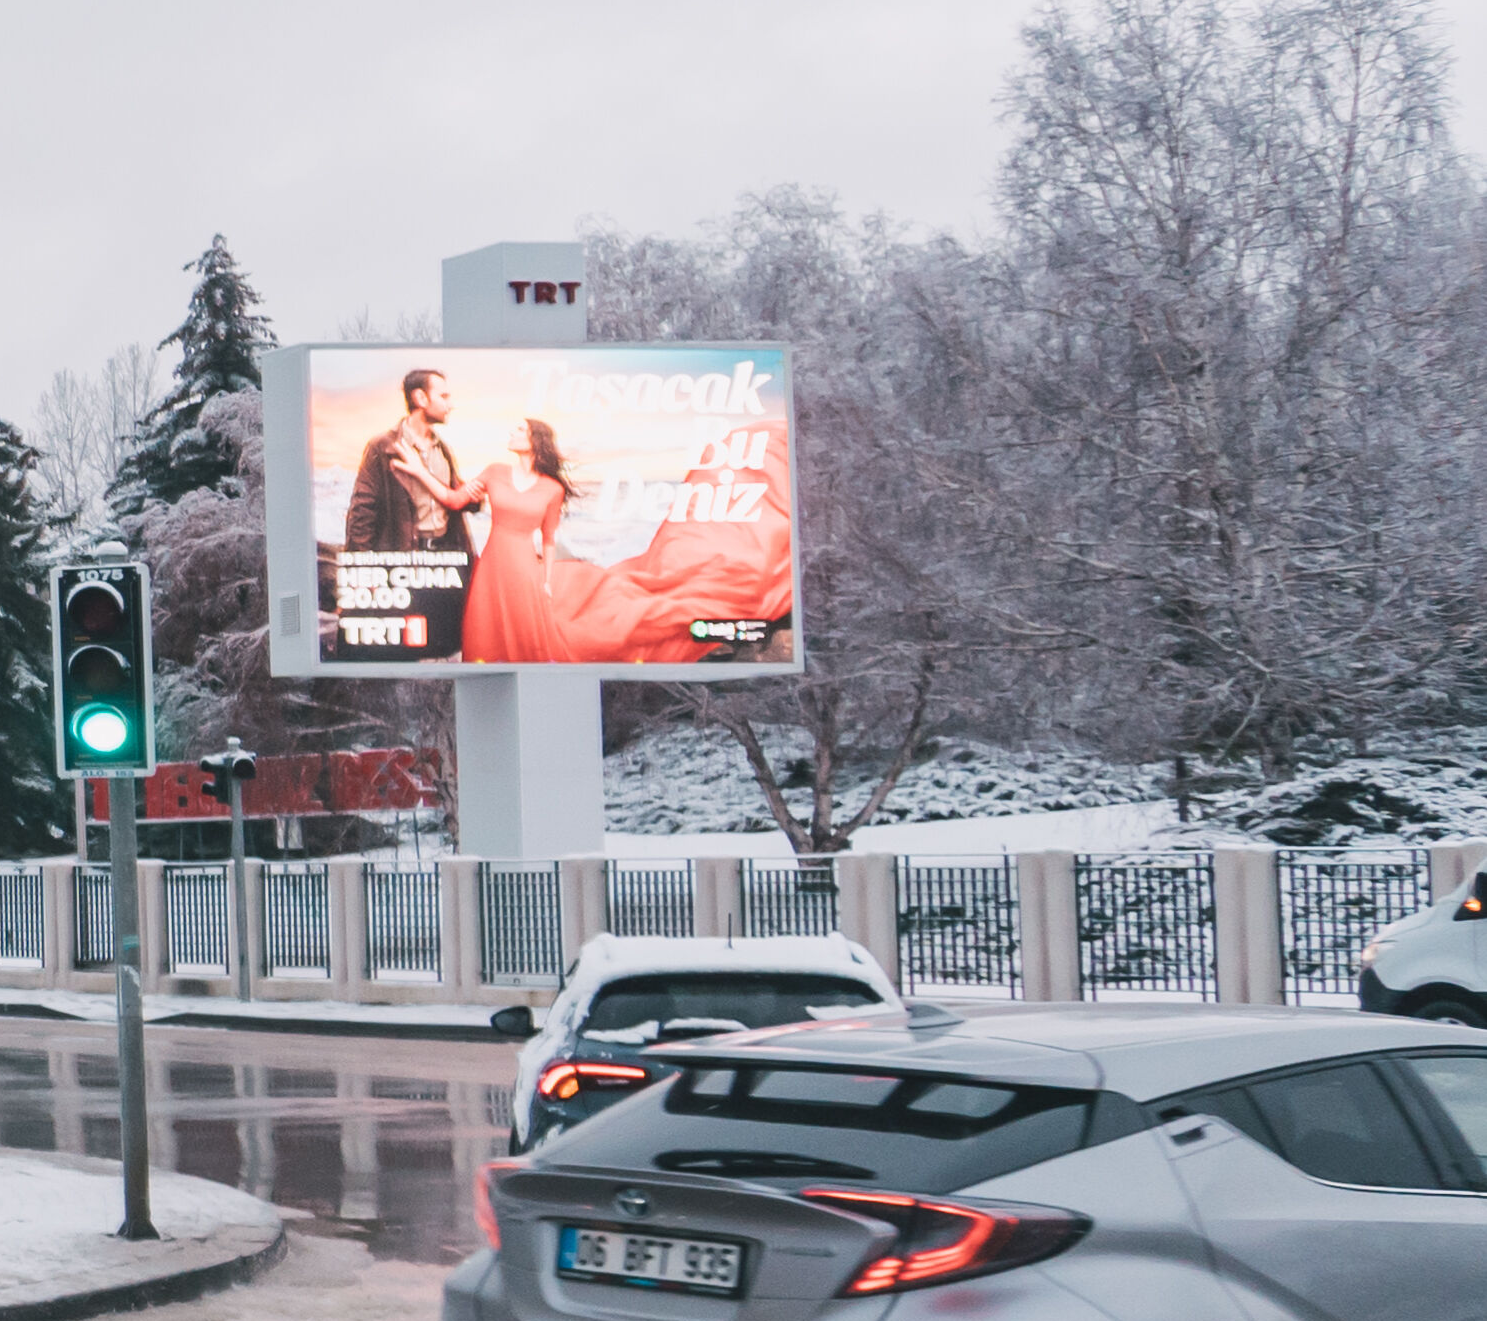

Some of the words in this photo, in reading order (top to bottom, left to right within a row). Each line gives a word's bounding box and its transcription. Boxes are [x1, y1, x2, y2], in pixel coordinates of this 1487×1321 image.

[508, 281, 582, 305] TRT
[687, 417, 769, 470] Bu
[596, 468, 768, 523] Deniz
[77, 569, 124, 582] 1075
[337, 566, 388, 588] HER
[389, 566, 463, 589] CUMA
[337, 587, 412, 610] 20.00
[578, 1233, 607, 1268] 06
[624, 1237, 674, 1276] BFT
[684, 1244, 734, 1283] 935
